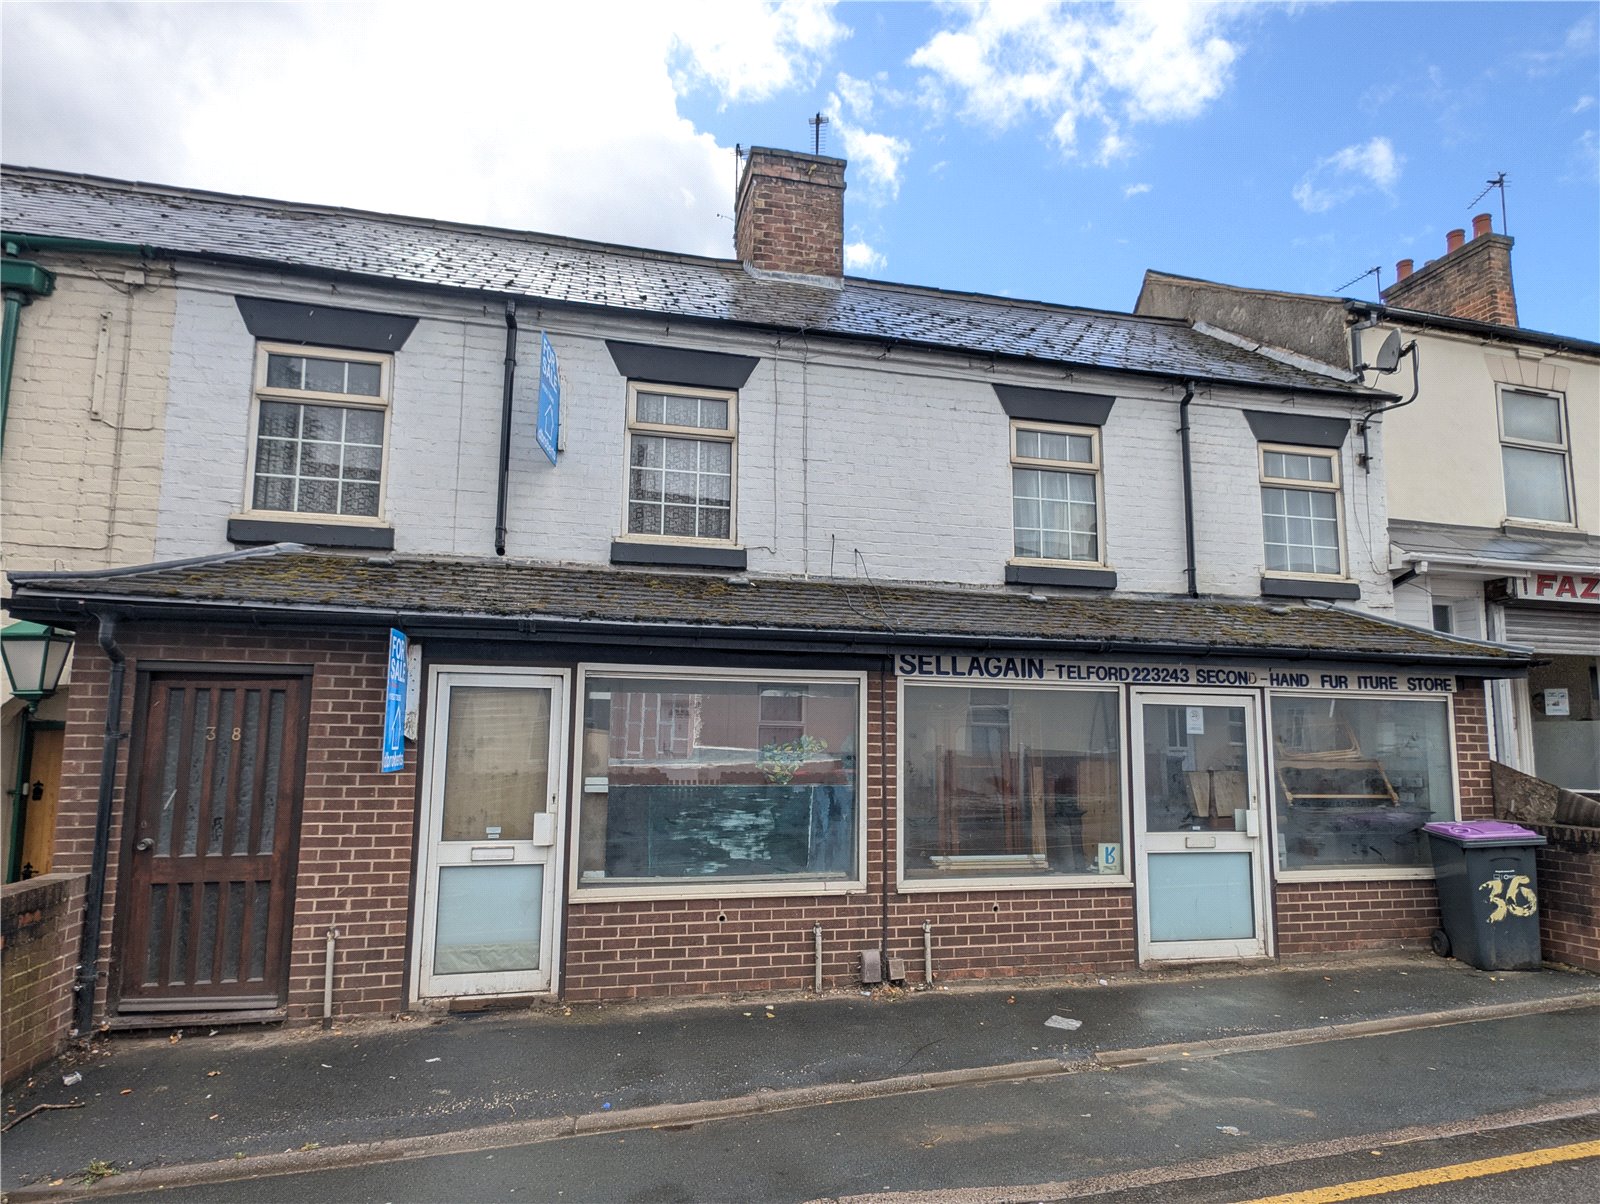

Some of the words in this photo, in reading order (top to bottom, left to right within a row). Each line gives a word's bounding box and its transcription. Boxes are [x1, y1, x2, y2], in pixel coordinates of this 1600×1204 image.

[542, 356, 557, 393] SALE
[392, 636, 405, 660] FOR
[391, 658, 406, 683] SALE
[899, 654, 1044, 679] SELLAGAIN
[1055, 664, 1130, 681] TELFORD
[1132, 667, 1190, 683] 223243
[1269, 672, 1310, 688] HAND
[1407, 677, 1453, 692] STORE
[1479, 875, 1537, 923] 36
